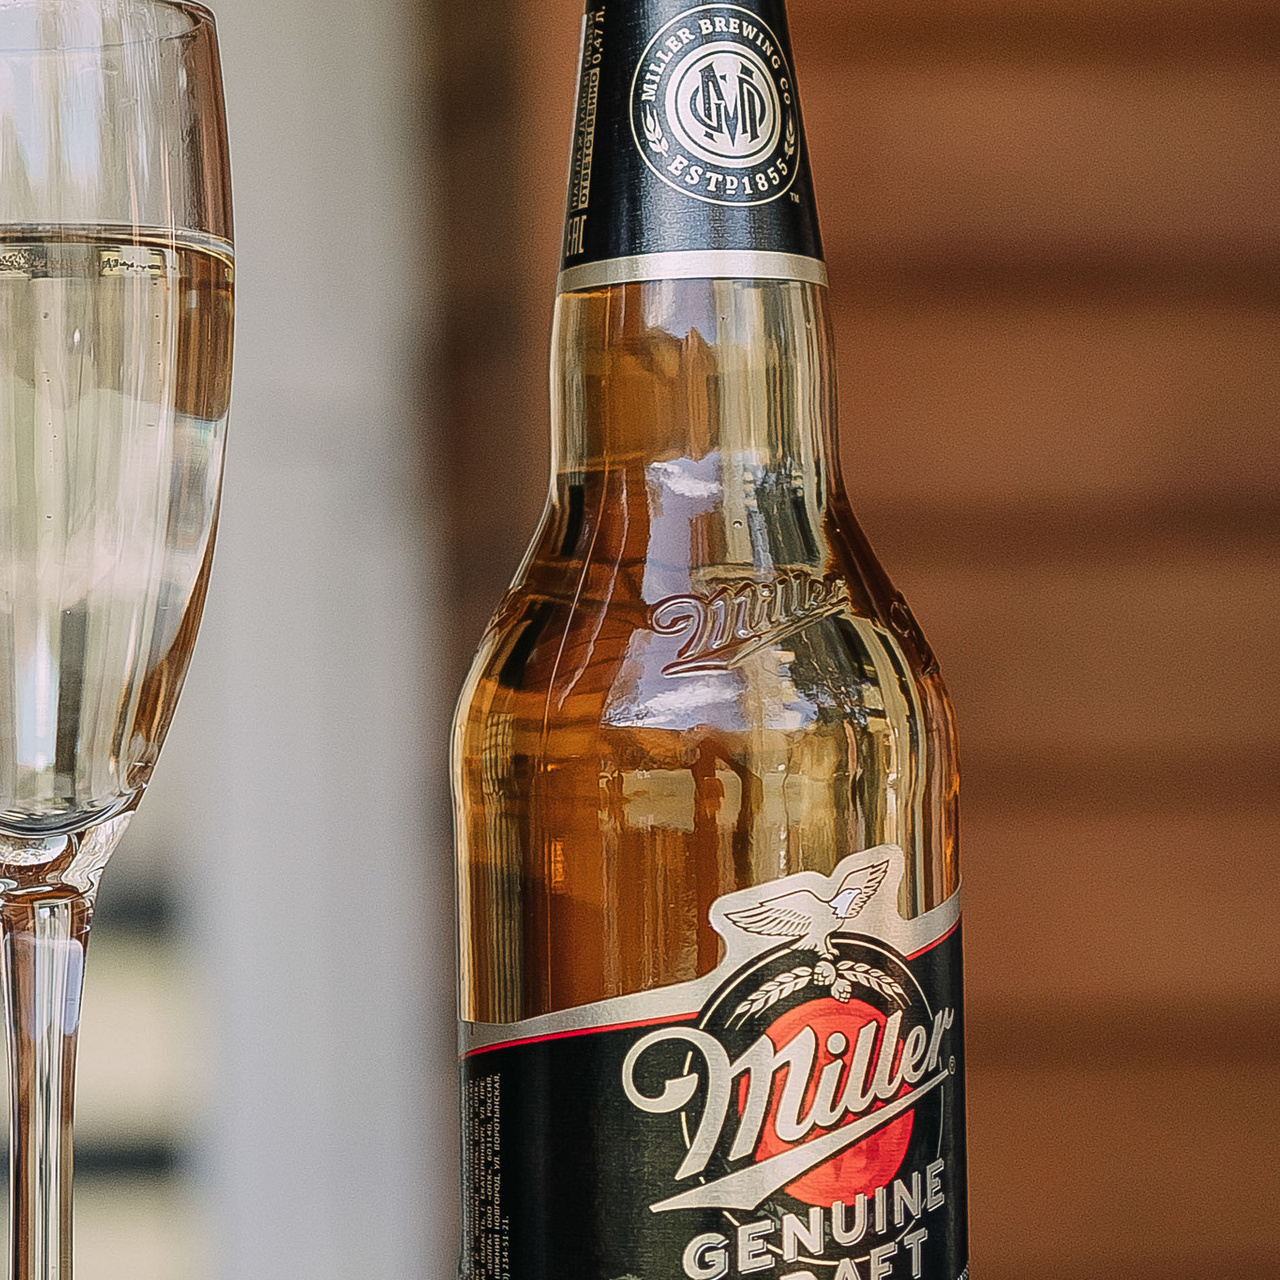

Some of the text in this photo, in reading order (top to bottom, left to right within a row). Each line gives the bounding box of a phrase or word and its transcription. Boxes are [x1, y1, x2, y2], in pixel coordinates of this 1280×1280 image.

[590, 27, 604, 65] 0,47
[641, 27, 696, 102] MILLER
[698, 16, 782, 70] BREWING
[579, 70, 599, 208] ОТВЕТСТВЕННО
[741, 158, 788, 194] 1855
[650, 569, 852, 660] Miller
[622, 1006, 955, 1182] Miller
